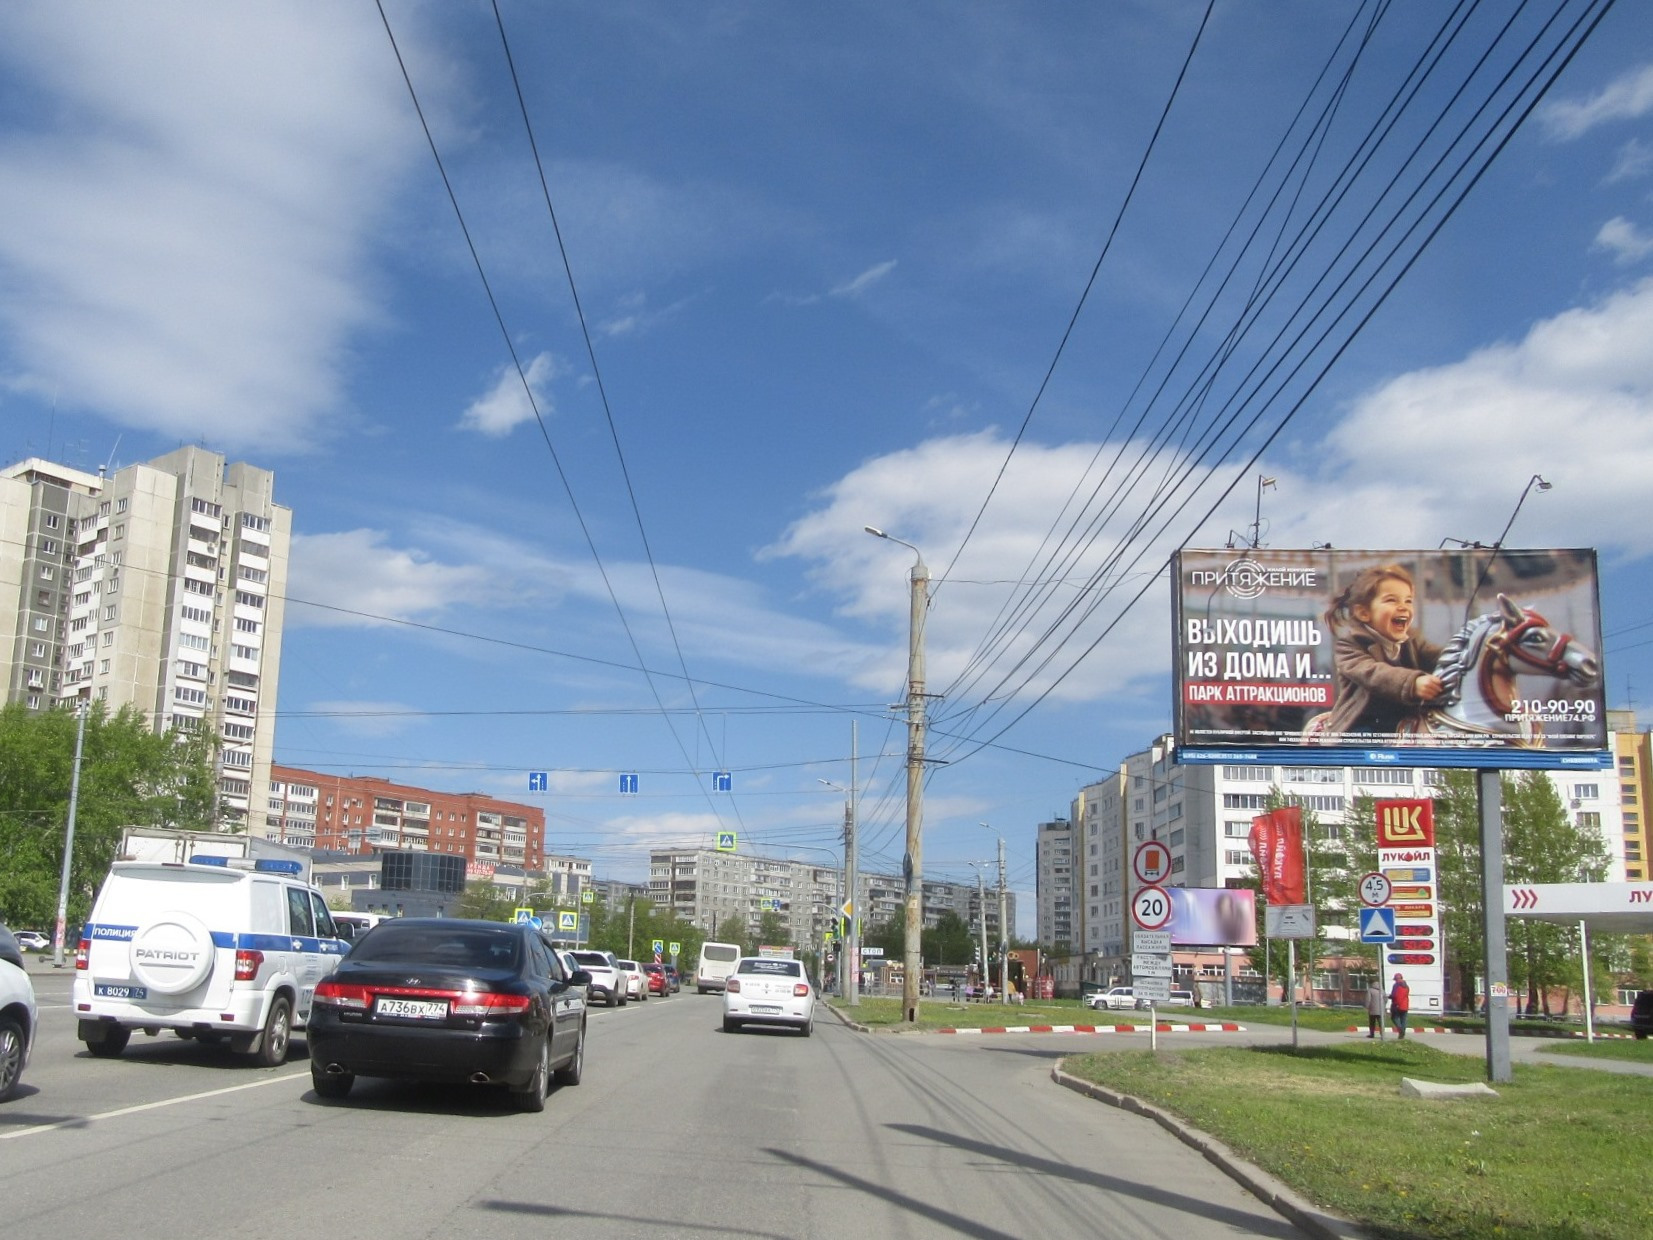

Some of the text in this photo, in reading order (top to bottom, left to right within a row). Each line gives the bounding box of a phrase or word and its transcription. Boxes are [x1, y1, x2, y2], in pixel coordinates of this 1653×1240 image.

[1192, 571, 1317, 587] ПРИТЯЖЕНИЕ
[1187, 618, 1322, 649] ВЫХОДИШЬ
[1188, 651, 1332, 681] ИЗ ДОМА И...
[1188, 685, 1327, 704] ПАРК АТТРАКЦИОНОВ
[1510, 699, 1596, 714] 210-90-90
[1504, 713, 1597, 722] ПРИТЯЖЕНИЕ74.РФ
[1381, 851, 1431, 862] ЛУКОЙЛ
[1365, 879, 1384, 891] 4.5
[1141, 898, 1163, 917] 20
[94, 927, 138, 938] ПОЛИЦИЯ
[135, 948, 200, 961] PATRIOT
[107, 986, 130, 997] 8029
[134, 987, 144, 998] 74
[380, 1000, 446, 1015] А736ВХ 774
